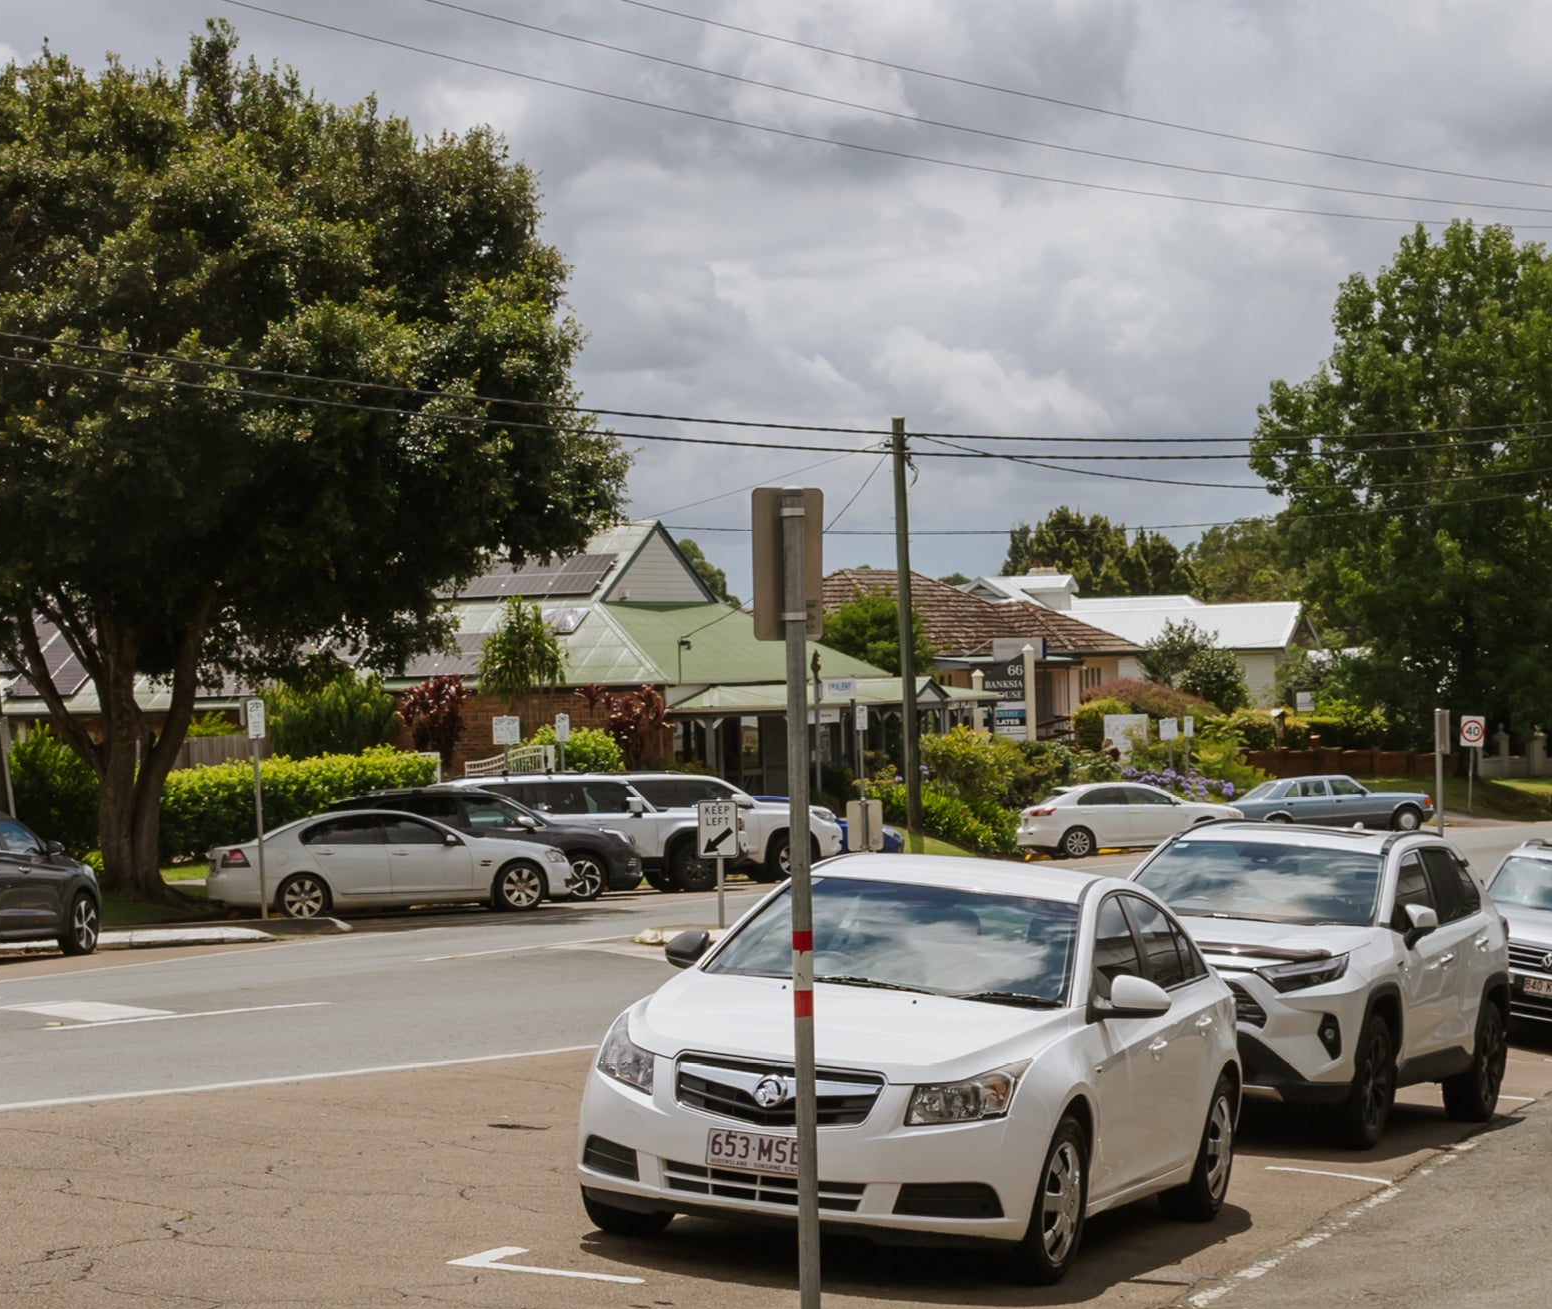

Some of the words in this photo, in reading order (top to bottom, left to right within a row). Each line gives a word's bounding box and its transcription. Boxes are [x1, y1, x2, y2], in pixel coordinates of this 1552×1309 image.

[1007, 664, 1024, 676] 66
[984, 680, 1024, 689] BANKSIA
[1465, 726, 1480, 736] 40
[704, 805, 731, 815] KEEP
[705, 817, 730, 826] LEFT
